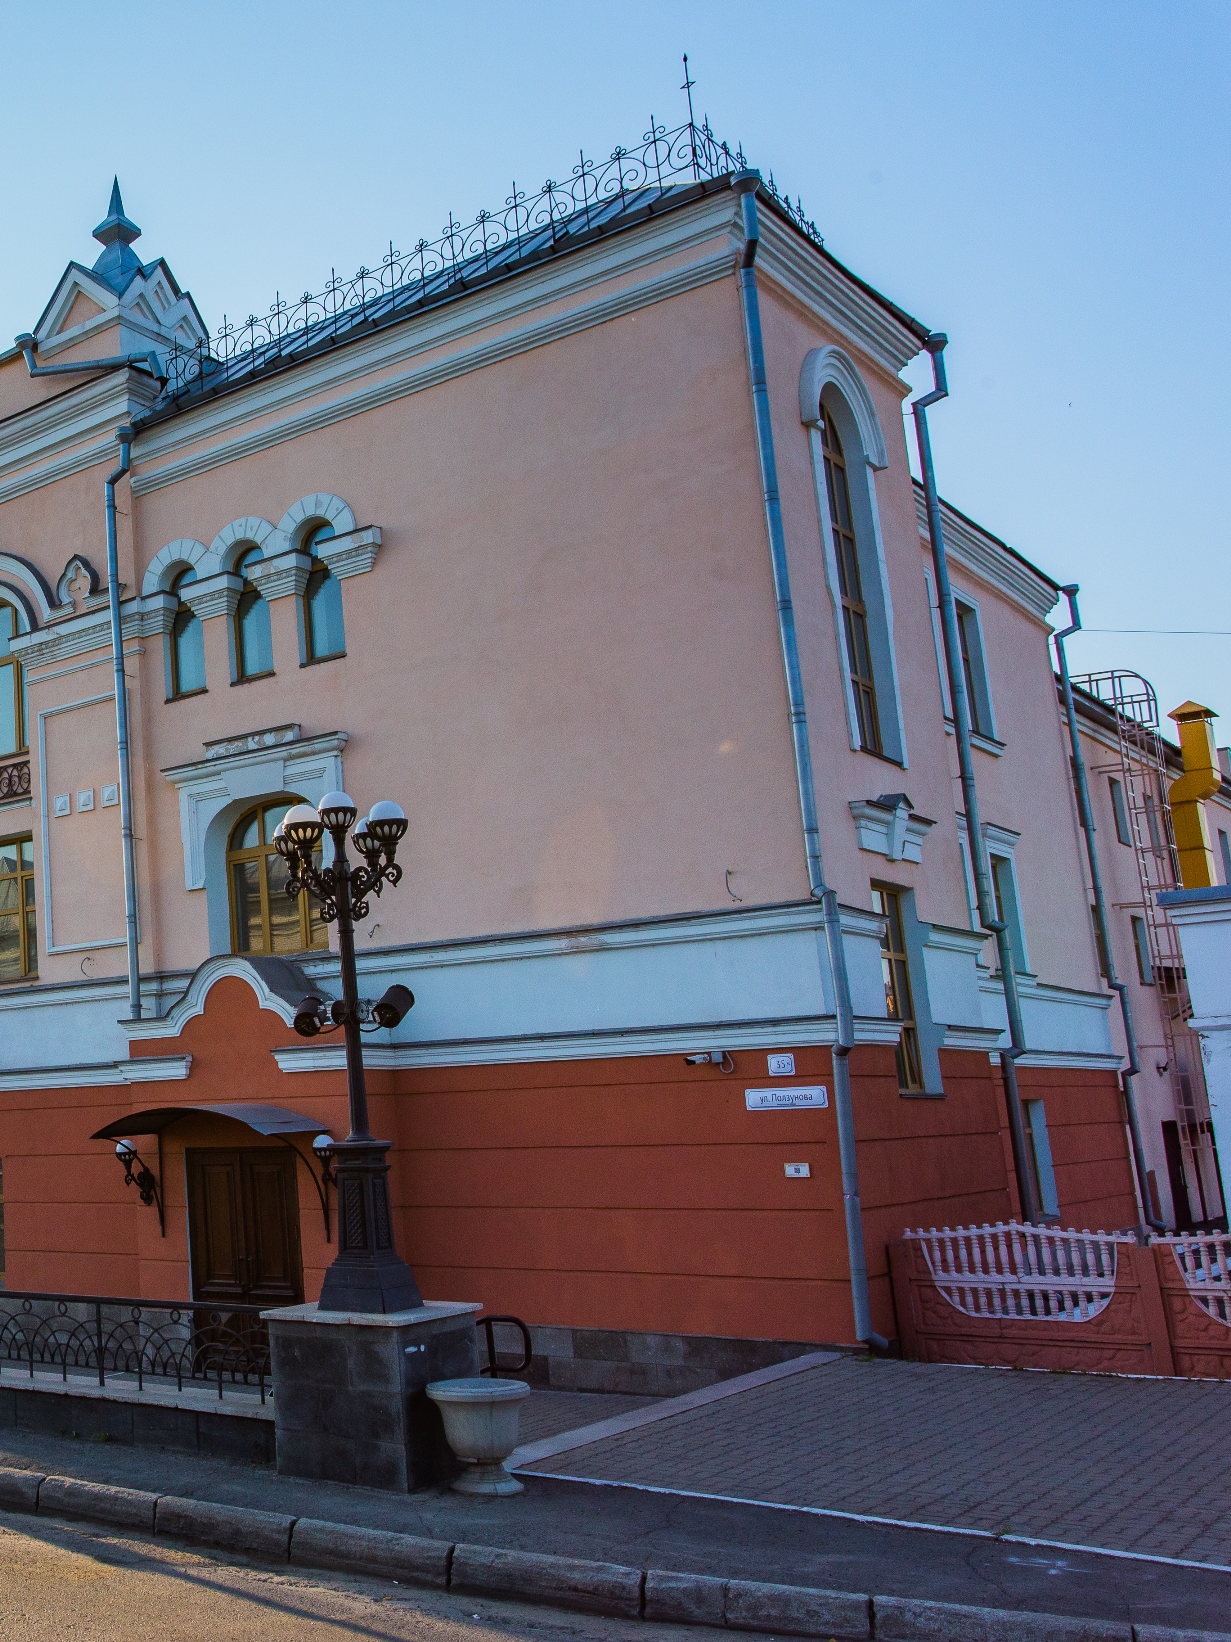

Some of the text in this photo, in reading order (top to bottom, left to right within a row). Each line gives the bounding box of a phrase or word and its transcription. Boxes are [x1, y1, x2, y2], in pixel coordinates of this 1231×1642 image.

[776, 1059, 785, 1069] 35
[759, 1093, 813, 1105] ул. Ползунова
